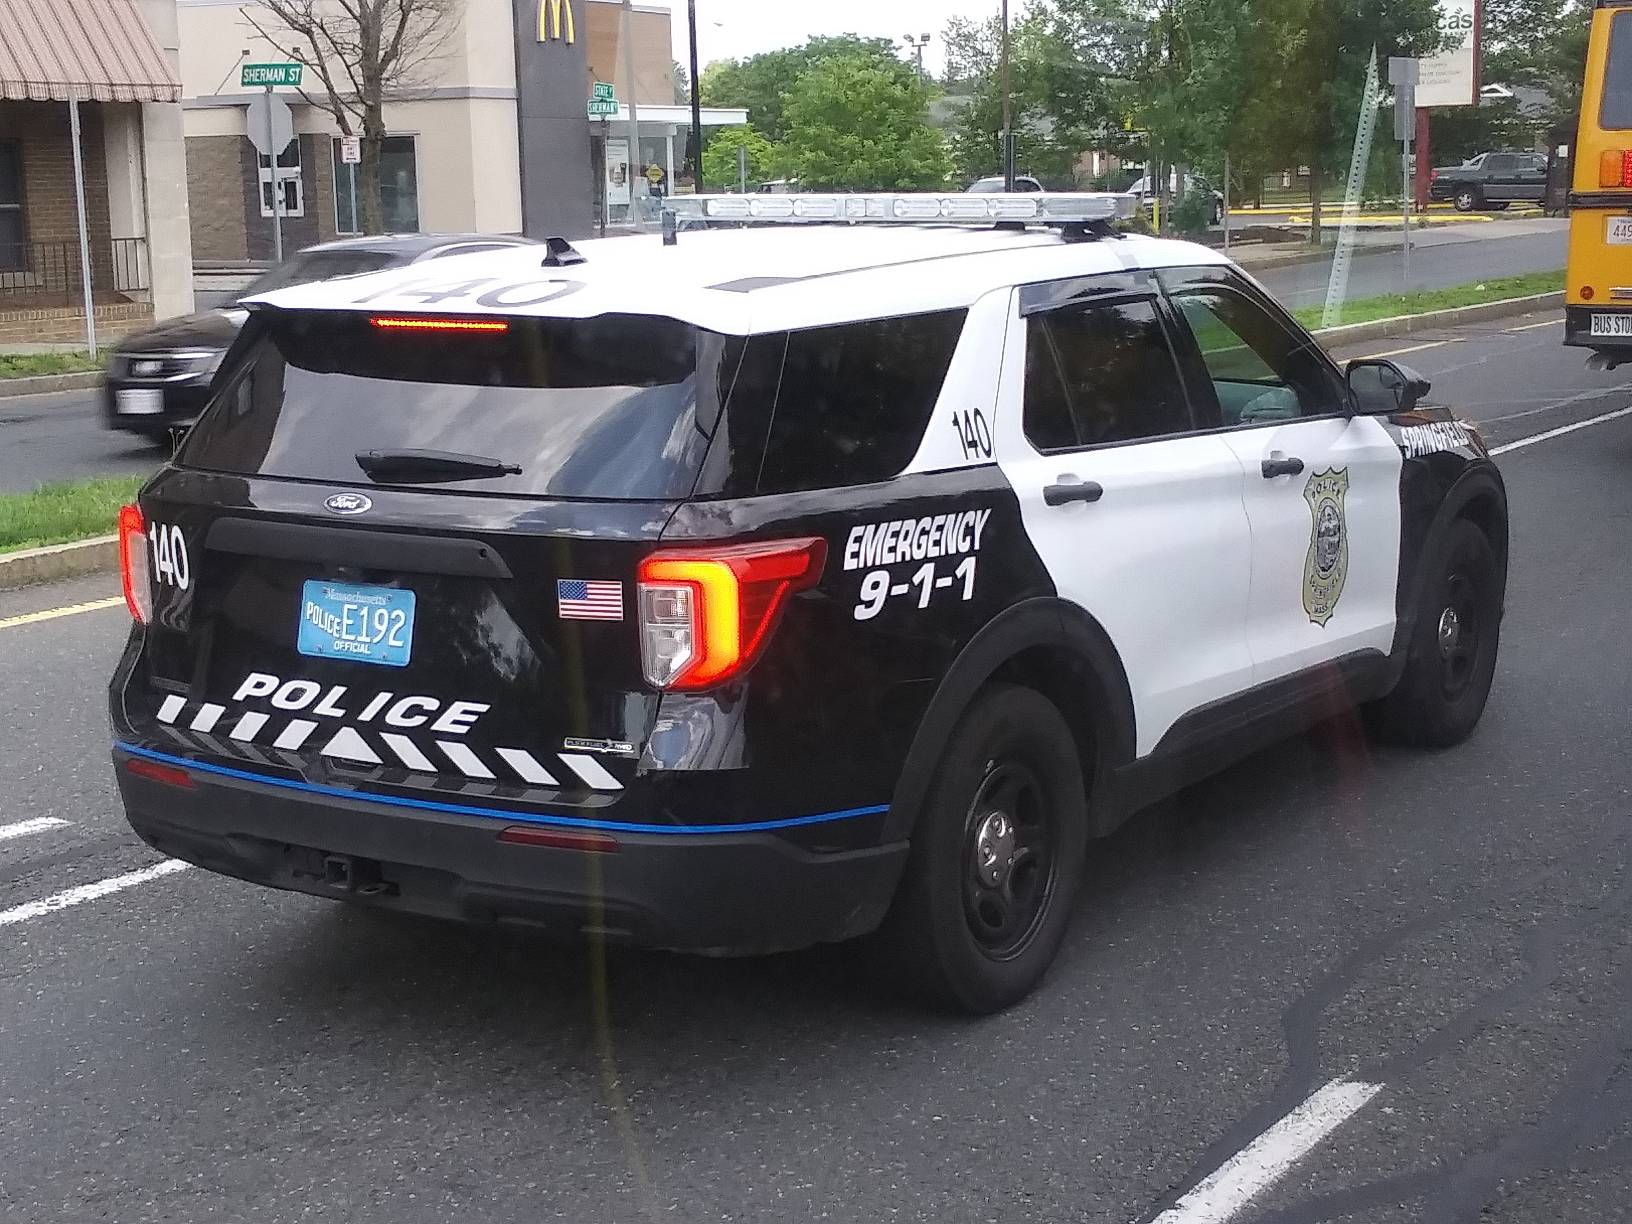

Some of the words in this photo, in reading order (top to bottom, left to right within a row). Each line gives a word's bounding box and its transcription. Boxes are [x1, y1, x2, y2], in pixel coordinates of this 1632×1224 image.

[243, 68, 286, 82] SHERMAN
[288, 68, 300, 82] ST
[350, 277, 587, 308] 140
[1593, 315, 1611, 334] BUS
[1614, 315, 1632, 334] STO
[952, 407, 992, 461] 140
[329, 495, 360, 509] Ford
[149, 521, 190, 590] 140
[843, 508, 992, 571] EMERGENCY
[853, 556, 977, 621] 9-1-1
[306, 601, 341, 638] POLICE
[341, 604, 406, 647] E192
[334, 640, 371, 654] OFFICIAL
[232, 672, 491, 734] POLICE
